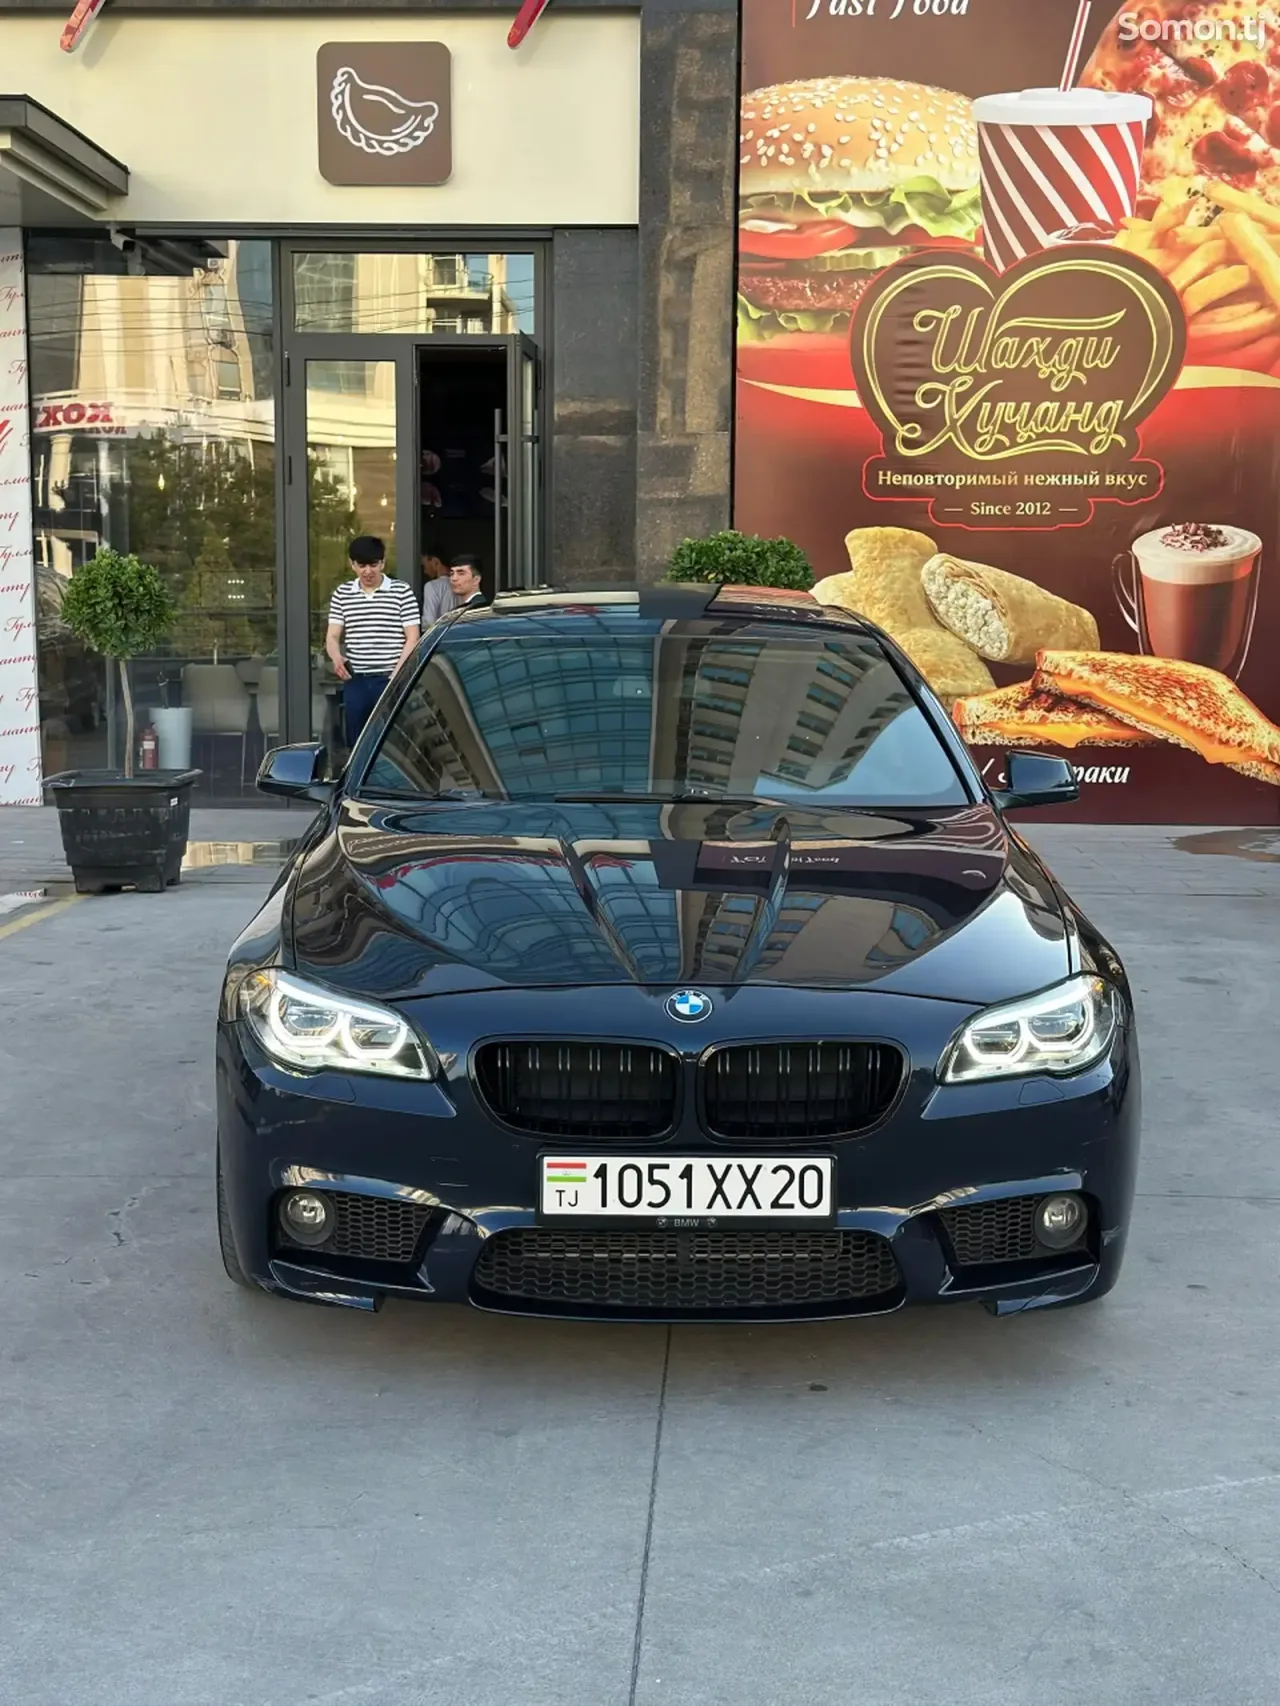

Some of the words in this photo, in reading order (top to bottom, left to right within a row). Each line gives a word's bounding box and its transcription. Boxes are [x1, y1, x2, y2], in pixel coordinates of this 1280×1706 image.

[878, 470, 1018, 489] Неповторимый
[1023, 471, 1100, 487] нежный
[1105, 474, 1148, 488] вкус
[970, 501, 1011, 515] Since
[1015, 501, 1052, 515] 2012
[593, 1163, 824, 1210] 1051XX20
[555, 1189, 578, 1207] TJ
[674, 1218, 699, 1227] BMW
